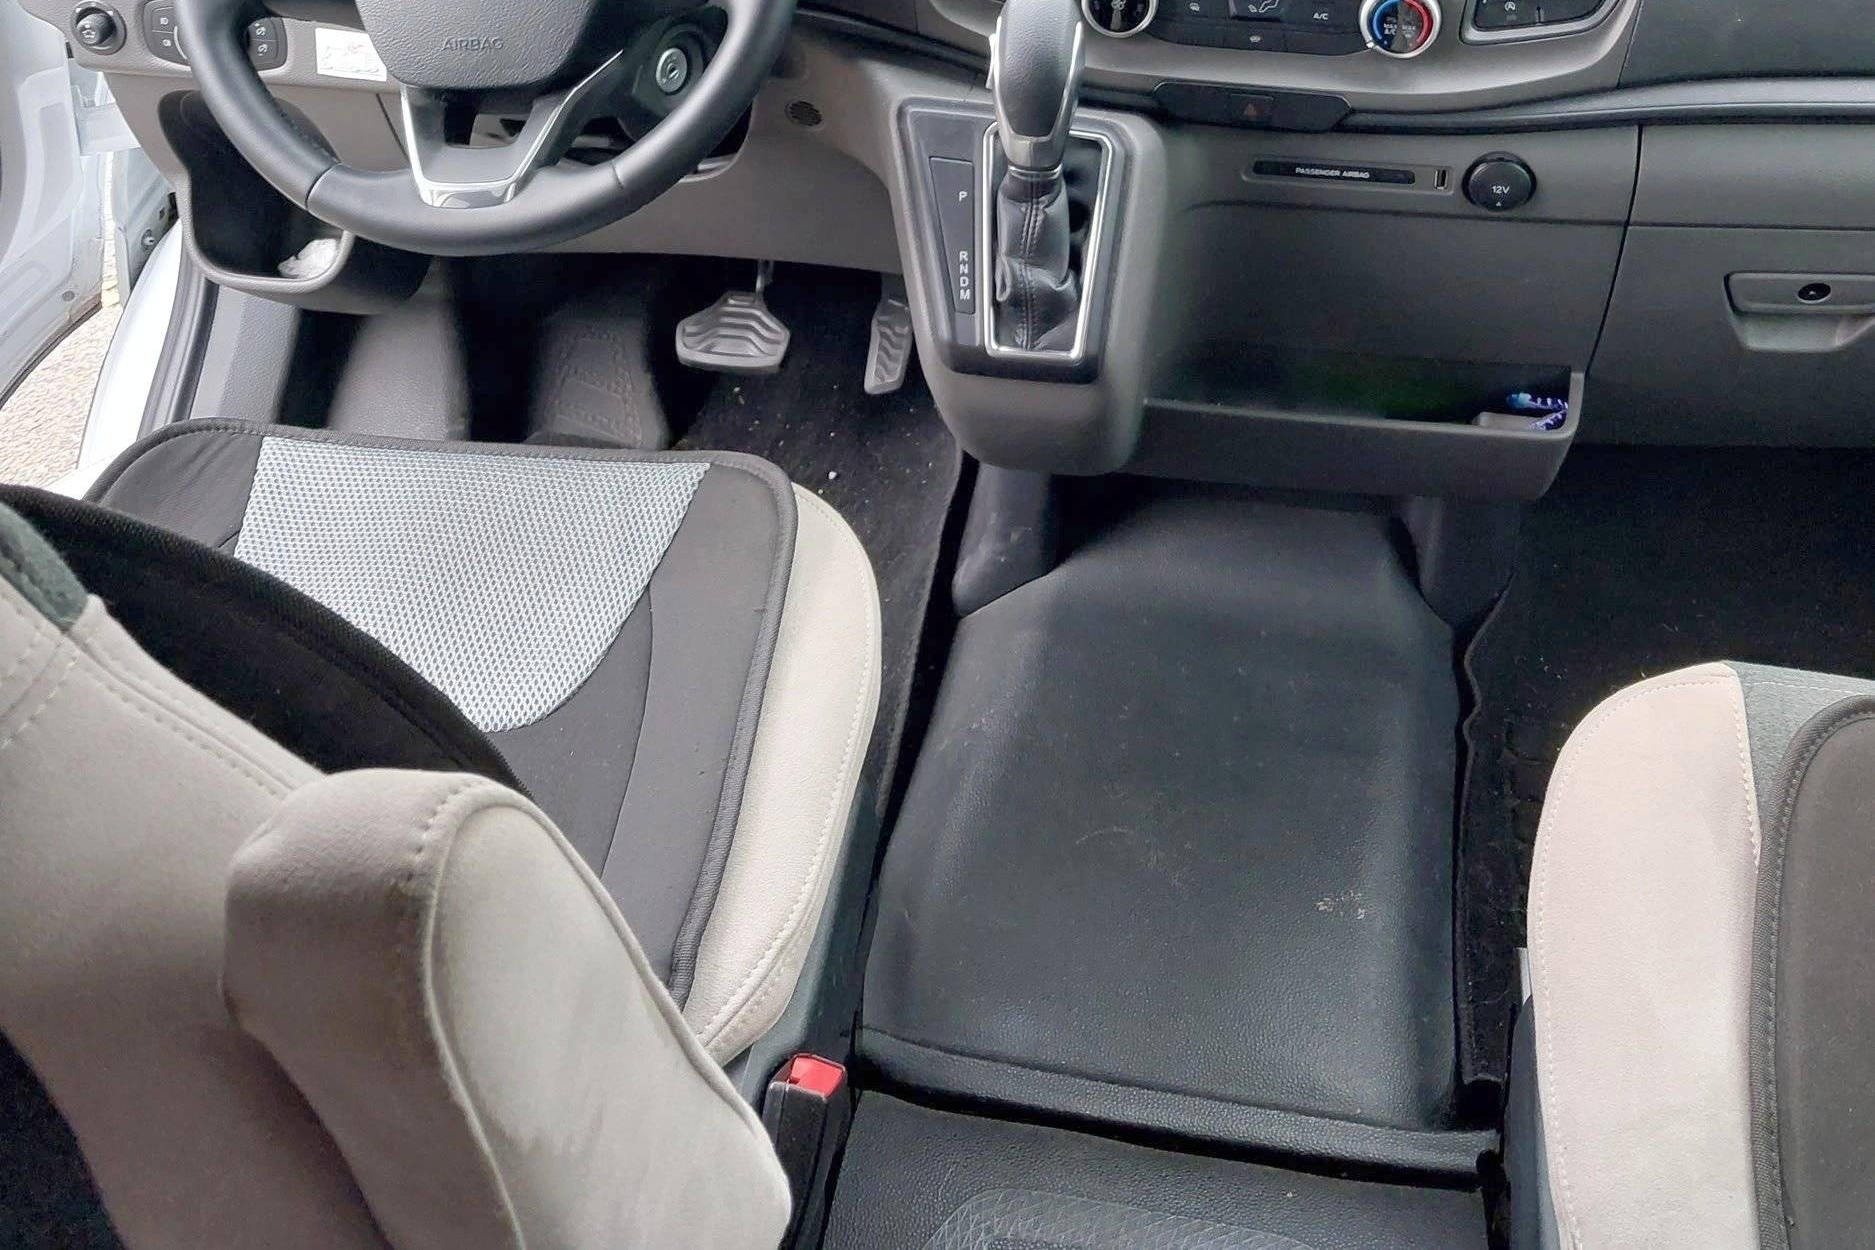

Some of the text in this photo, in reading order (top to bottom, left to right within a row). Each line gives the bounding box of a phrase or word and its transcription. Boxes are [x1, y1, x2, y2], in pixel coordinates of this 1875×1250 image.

[1312, 12, 1329, 20] A/C
[442, 37, 504, 51] AIRBAG
[1295, 167, 1370, 179] PASSENGER AIRBAG
[1491, 184, 1511, 194] 12V
[958, 190, 968, 201] P
[959, 251, 969, 261] R
[959, 264, 969, 274] N
[959, 277, 970, 288] D
[960, 289, 970, 300] M
